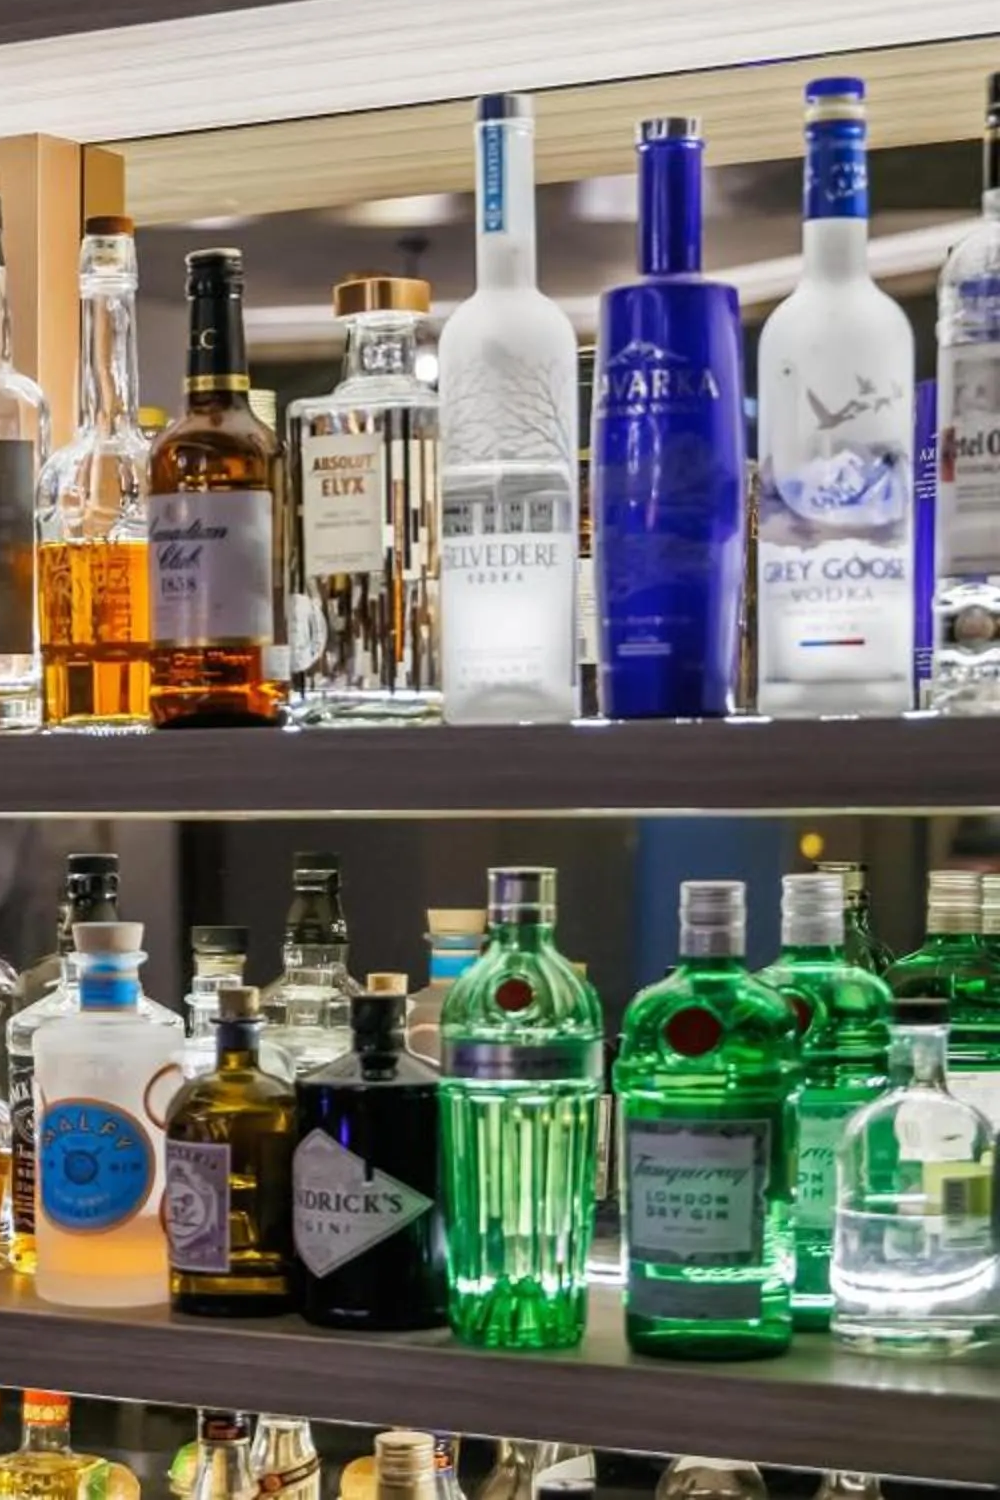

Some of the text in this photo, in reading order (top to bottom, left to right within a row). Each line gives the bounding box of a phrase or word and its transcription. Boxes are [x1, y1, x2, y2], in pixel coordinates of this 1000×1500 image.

[313, 454, 376, 471] ABSOLUT
[321, 476, 365, 497] ELYX
[790, 586, 874, 603] VODKA
[634, 1153, 751, 1186] Tanqueray
[303, 1189, 404, 1215] DRICK'S
[645, 1190, 729, 1205] LONDON
[646, 1205, 729, 1220] DRY GIN
